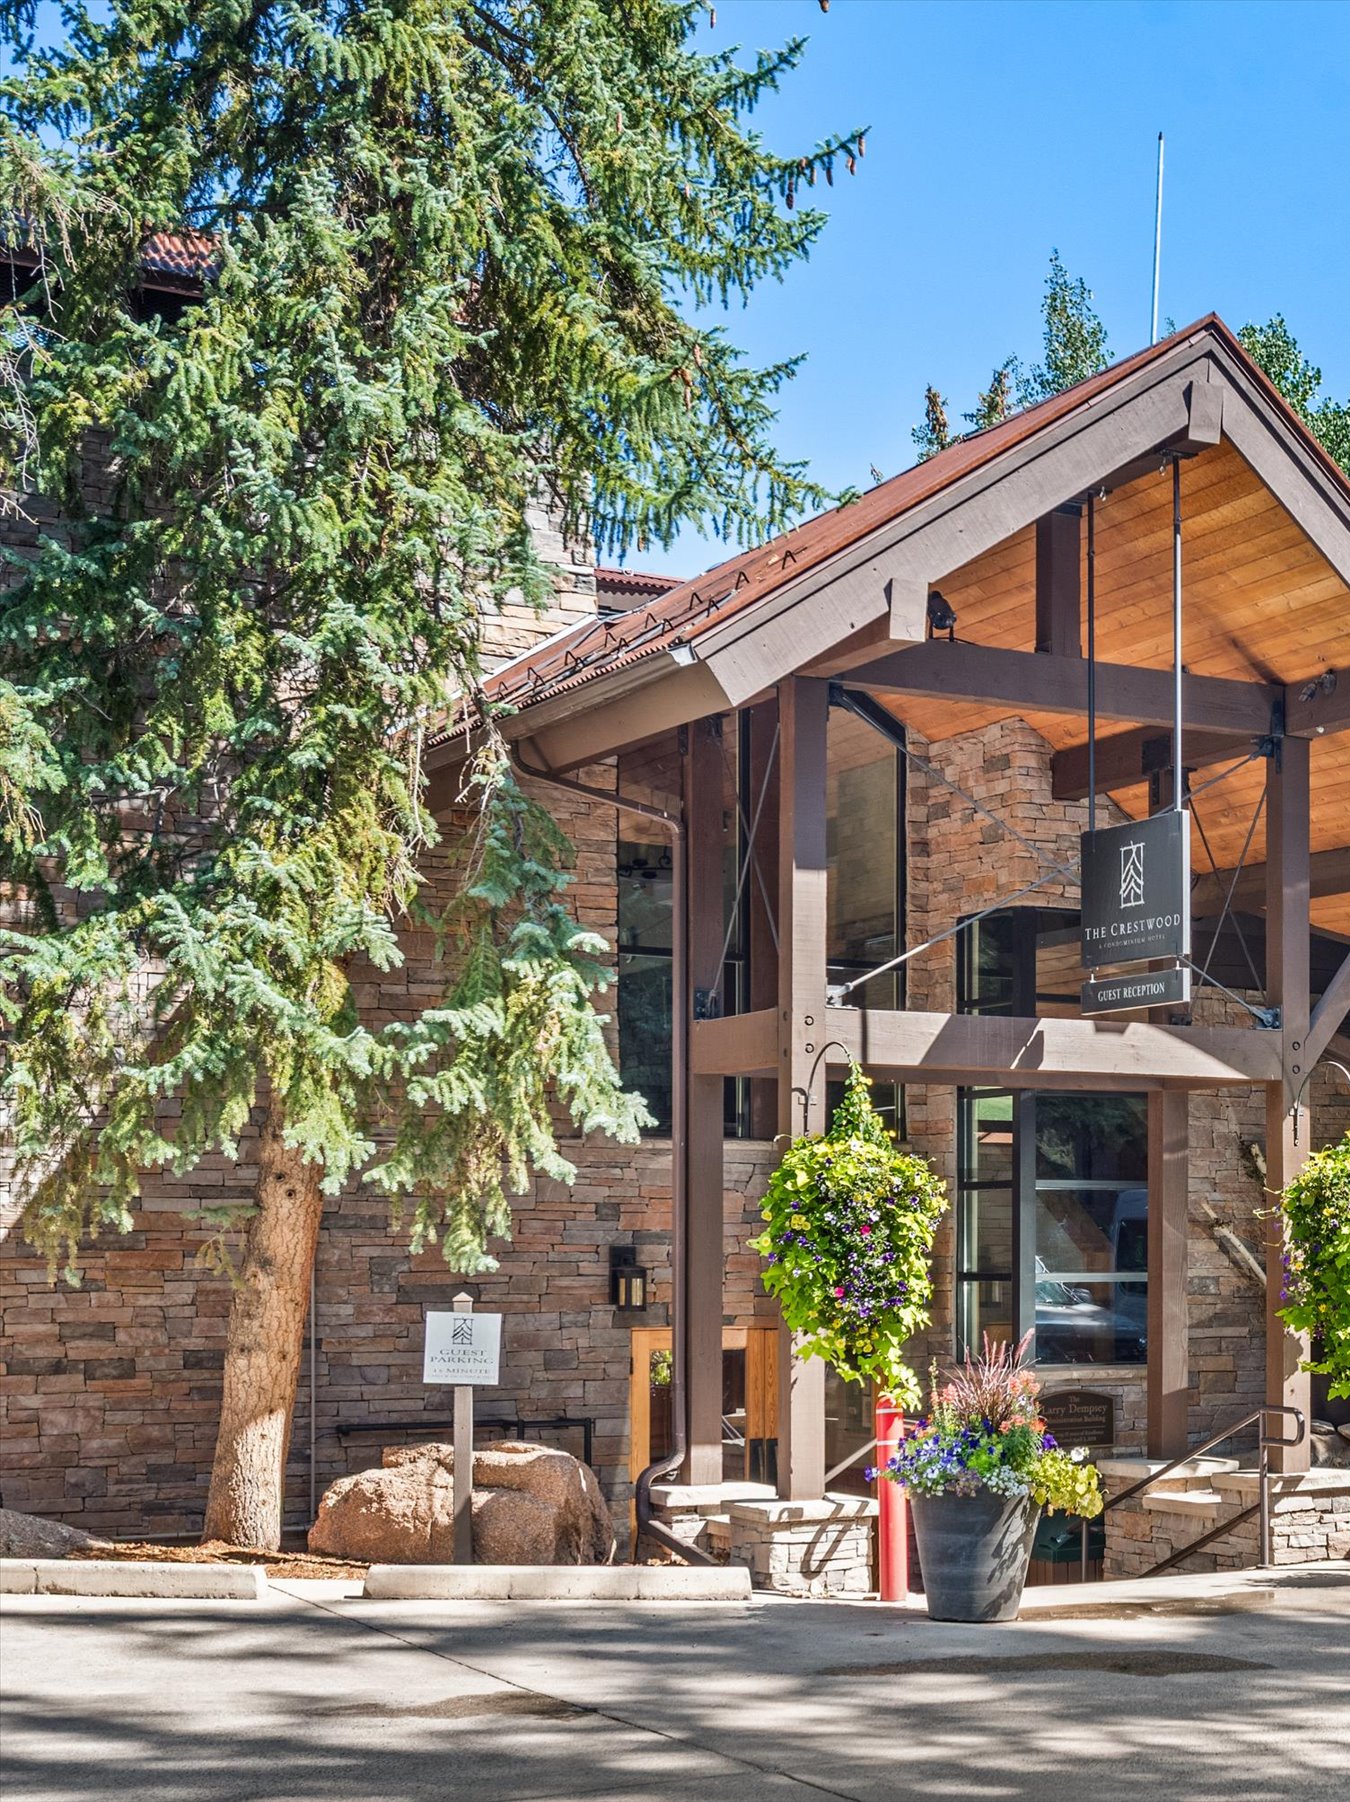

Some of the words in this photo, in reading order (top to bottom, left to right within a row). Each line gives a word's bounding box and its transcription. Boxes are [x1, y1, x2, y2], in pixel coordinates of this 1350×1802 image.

[1084, 927, 1107, 940] THE
[1110, 913, 1181, 937] CRESTWOOD
[1147, 933, 1166, 943] HOTEL
[1098, 987, 1122, 1002] GUEST
[1123, 982, 1166, 999] RECEPTION
[430, 1356, 494, 1364] PARKING
[1069, 1403, 1107, 1415] Dempsey
